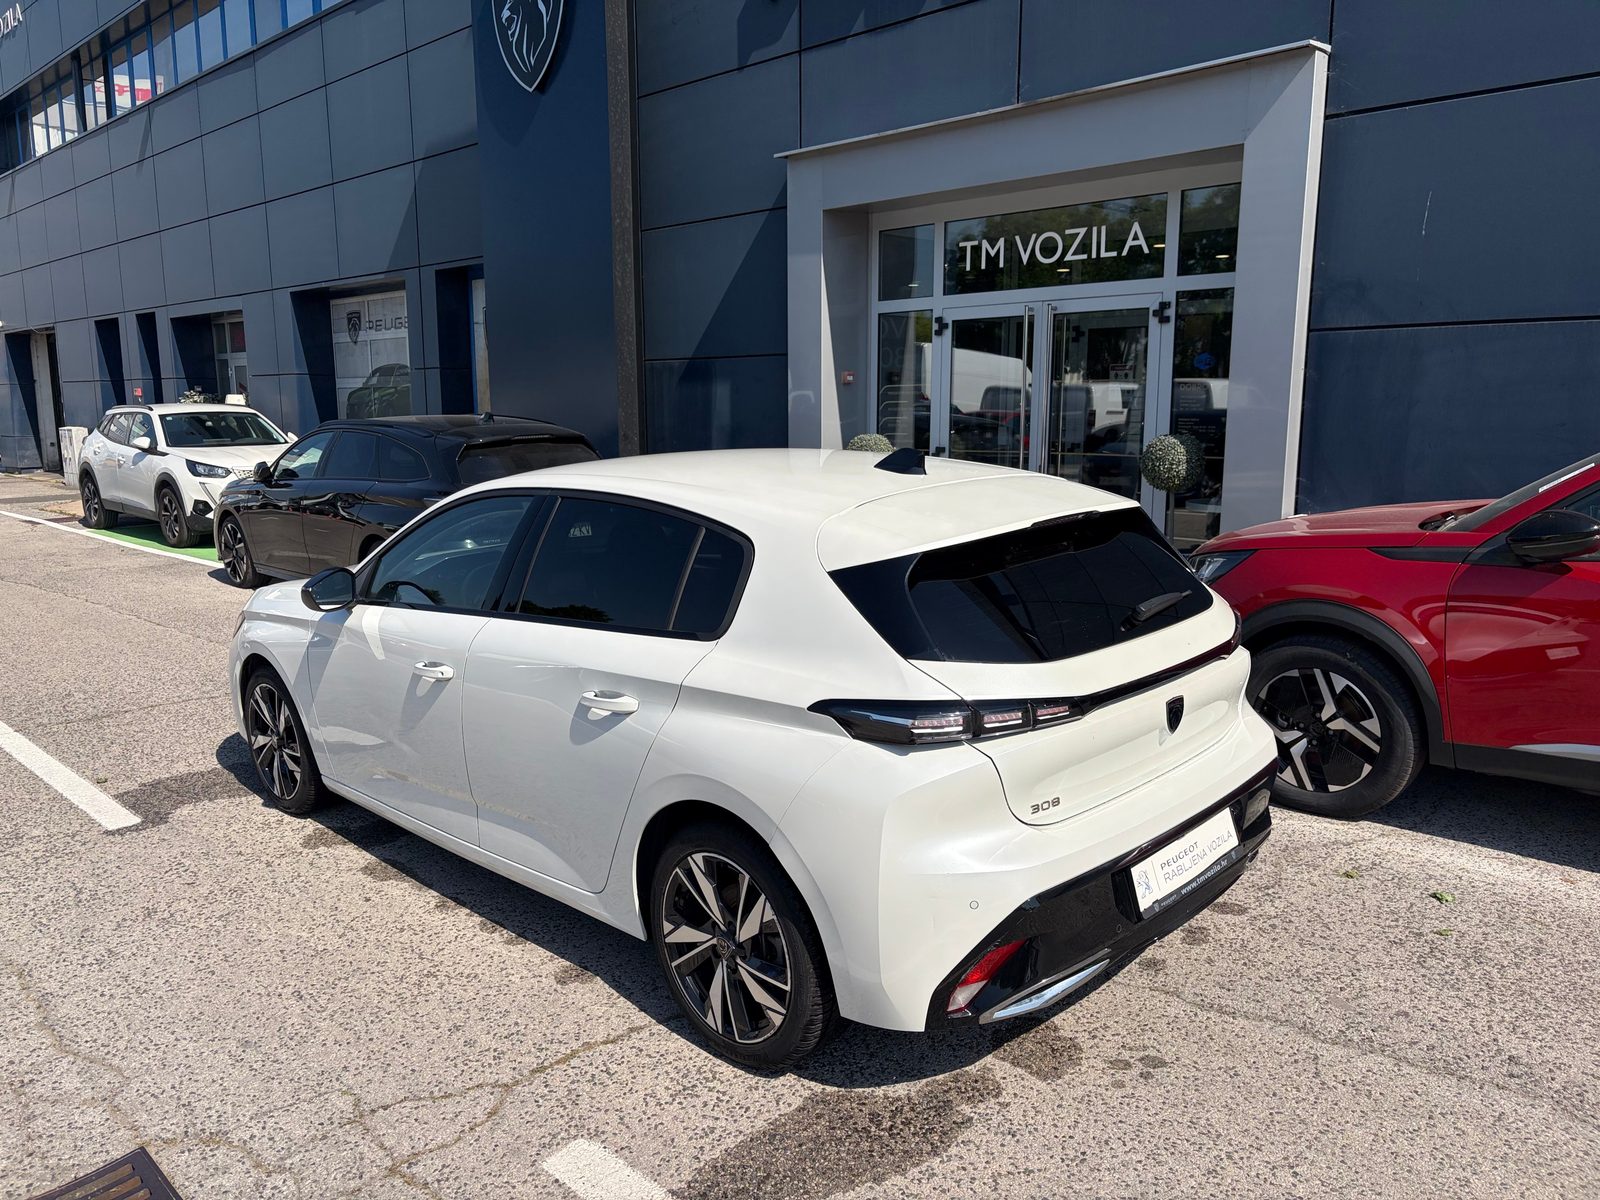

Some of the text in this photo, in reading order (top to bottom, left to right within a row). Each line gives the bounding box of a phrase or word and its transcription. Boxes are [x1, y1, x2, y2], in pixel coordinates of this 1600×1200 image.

[958, 221, 1149, 271] TM VOZILA
[1030, 797, 1060, 815] 308
[1160, 841, 1199, 871] PEUGEOT
[1163, 830, 1233, 884] RABLJENA VOZILA
[1181, 859, 1228, 895] www.tmvozila.hr
